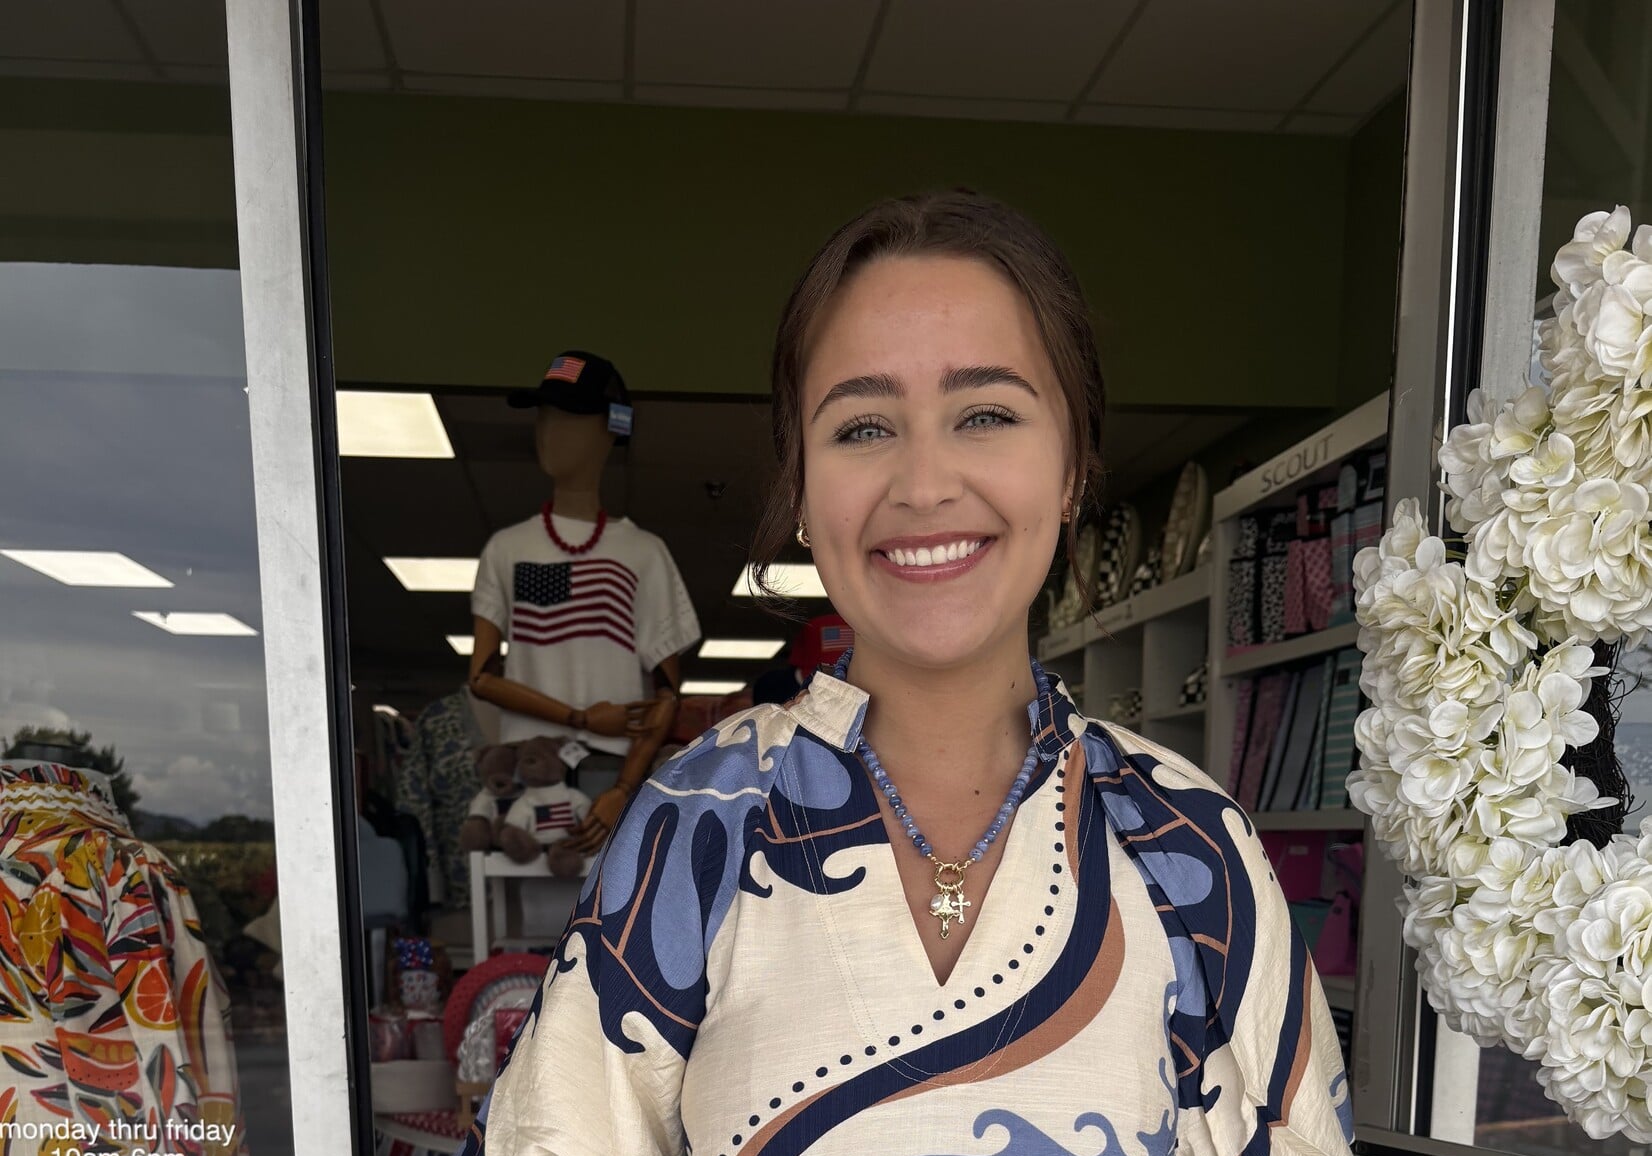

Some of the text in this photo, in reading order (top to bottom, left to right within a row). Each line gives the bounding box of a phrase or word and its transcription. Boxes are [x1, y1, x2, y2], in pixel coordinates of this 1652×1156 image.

[1260, 435, 1334, 494] SCOUT
[0, 1118, 236, 1146] monday thru friday
